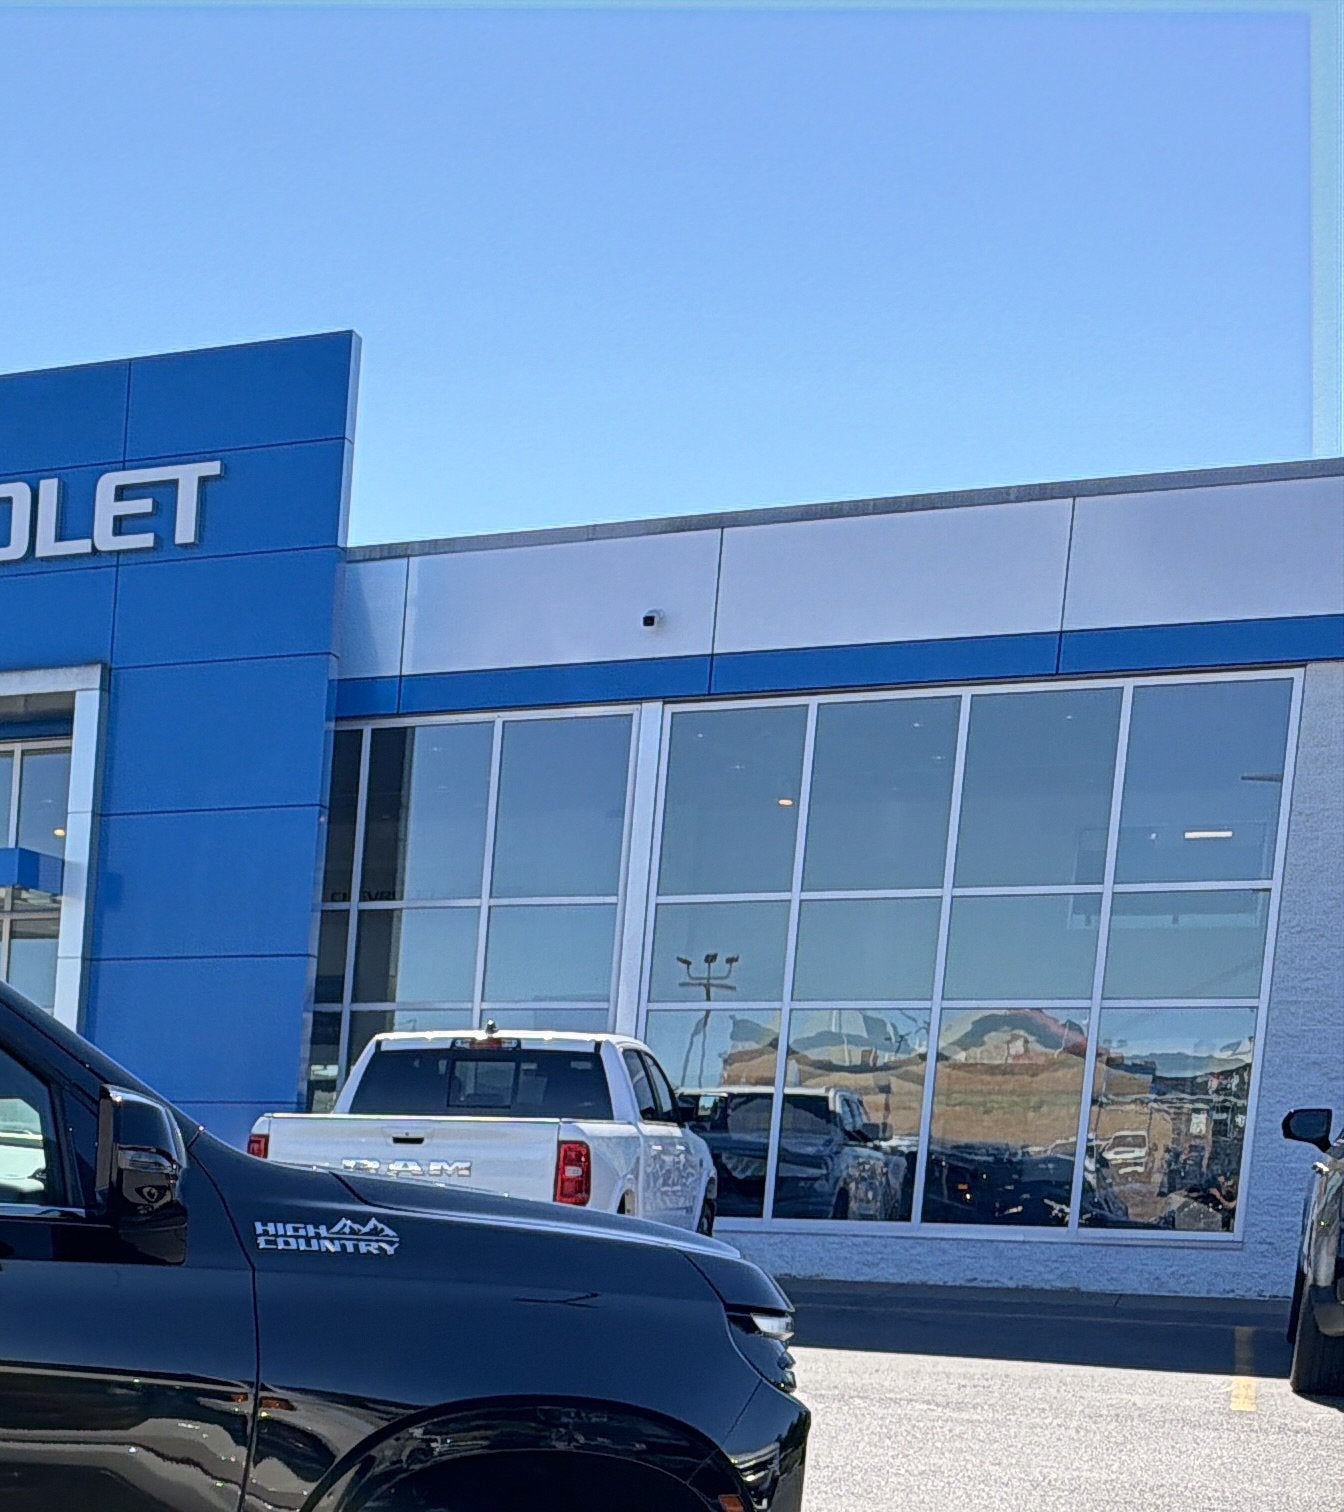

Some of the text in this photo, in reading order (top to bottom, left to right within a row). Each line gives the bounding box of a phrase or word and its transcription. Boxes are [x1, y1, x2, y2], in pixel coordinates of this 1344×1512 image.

[341, 1157, 472, 1177] RAM
[254, 1221, 328, 1238] HIGH
[256, 1235, 400, 1256] COUNTRY
